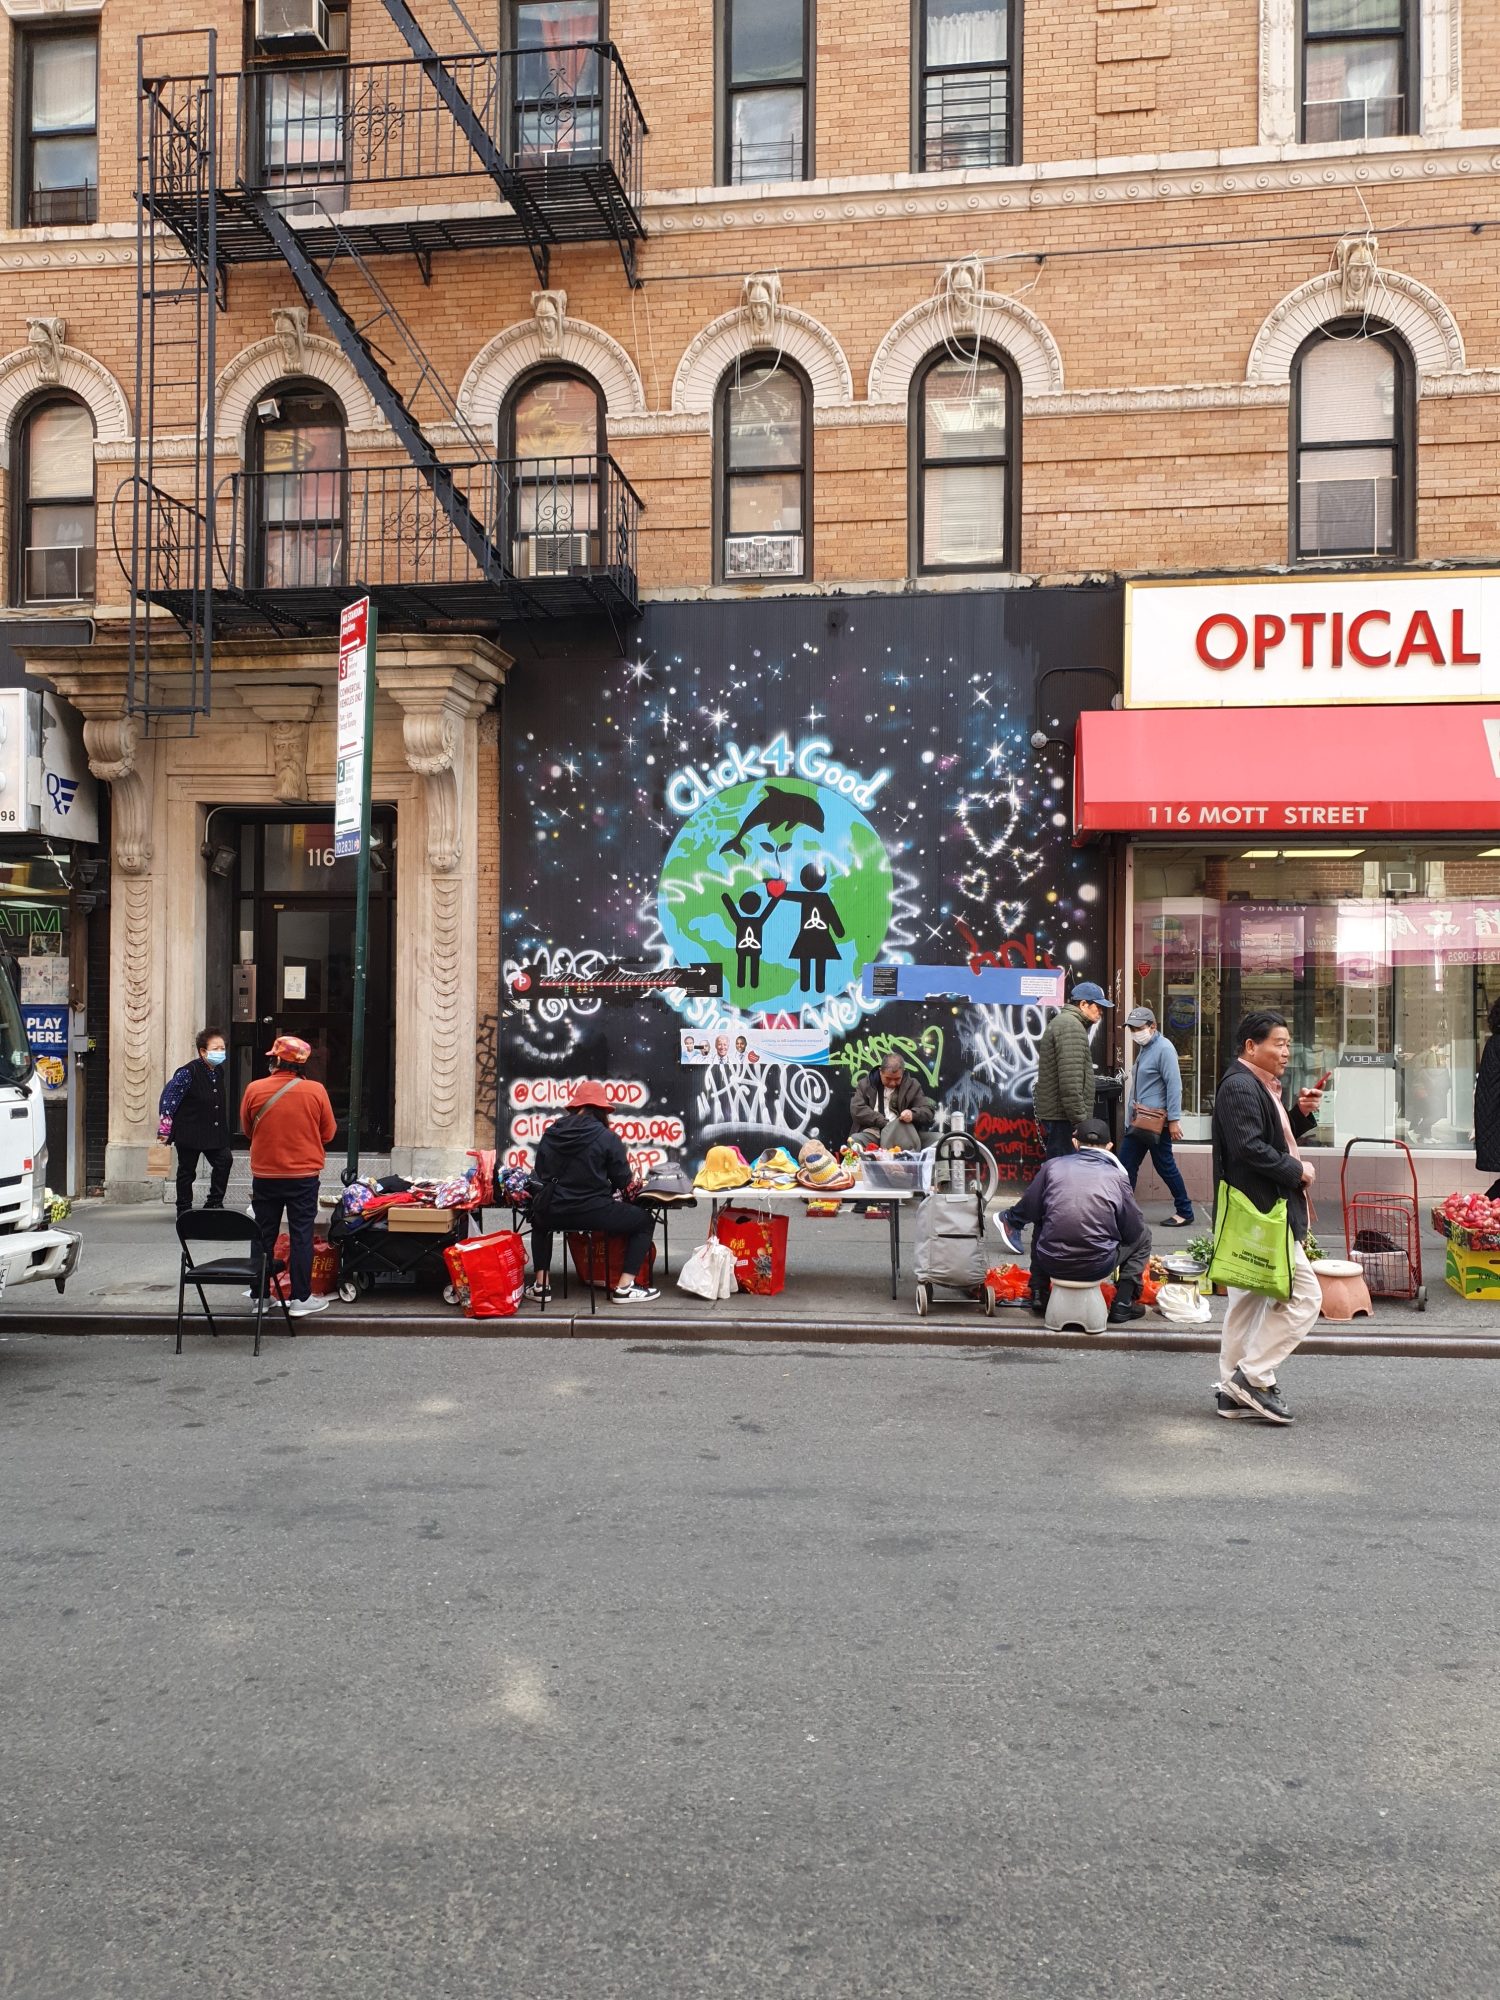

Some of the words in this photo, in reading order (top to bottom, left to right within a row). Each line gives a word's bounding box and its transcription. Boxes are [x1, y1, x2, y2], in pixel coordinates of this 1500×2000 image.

[1196, 608, 1481, 671] OPTICAL
[341, 658, 347, 678] 3
[339, 761, 344, 781] 2
[1148, 805, 1191, 824] 116
[1198, 806, 1269, 824] MOTT
[1284, 806, 1369, 824] STREET
[307, 848, 336, 867] 116
[26, 1017, 62, 1030] PLAY
[26, 1031, 67, 1044] HERE.
[508, 1150, 533, 1169] OR
